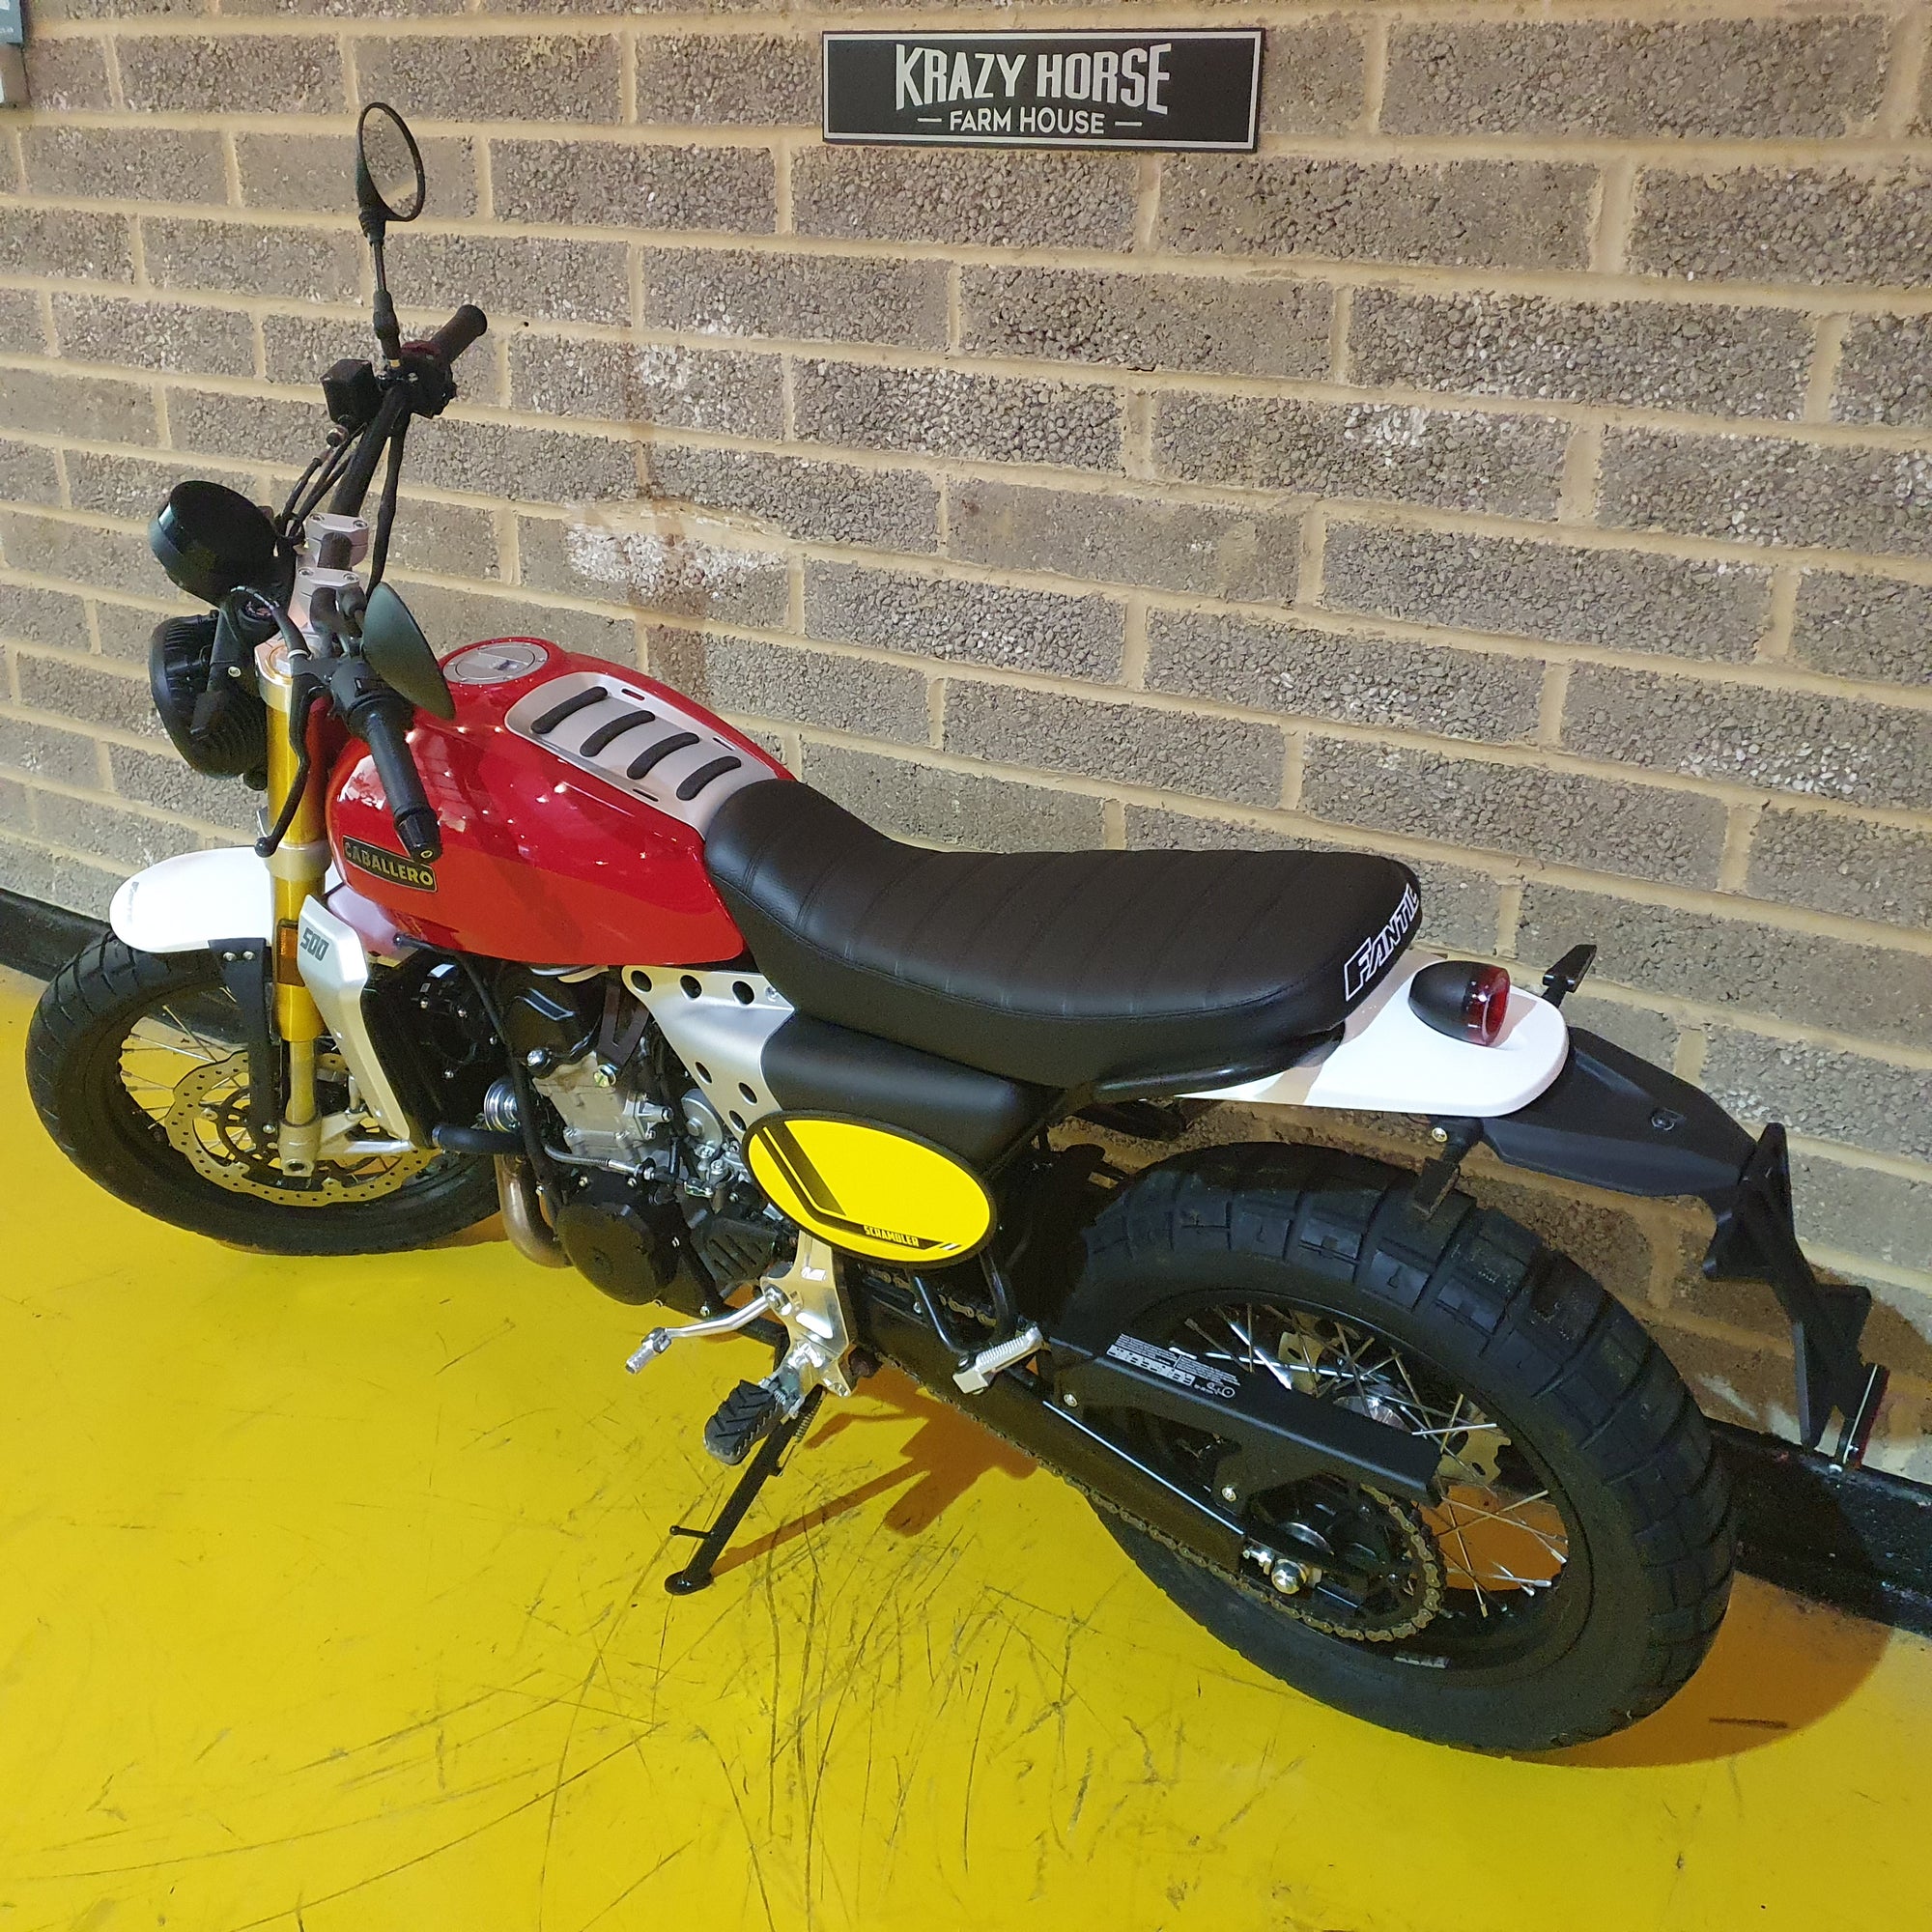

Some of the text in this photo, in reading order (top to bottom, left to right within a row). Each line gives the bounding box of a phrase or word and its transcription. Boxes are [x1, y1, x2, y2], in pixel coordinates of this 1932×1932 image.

[895, 43, 1172, 115] KRAZY HORSE
[950, 106, 1105, 134] FARM HOUSE
[344, 841, 434, 886] CABALLERO
[299, 926, 330, 962] 500
[863, 1224, 920, 1248] SCRAMBLER
